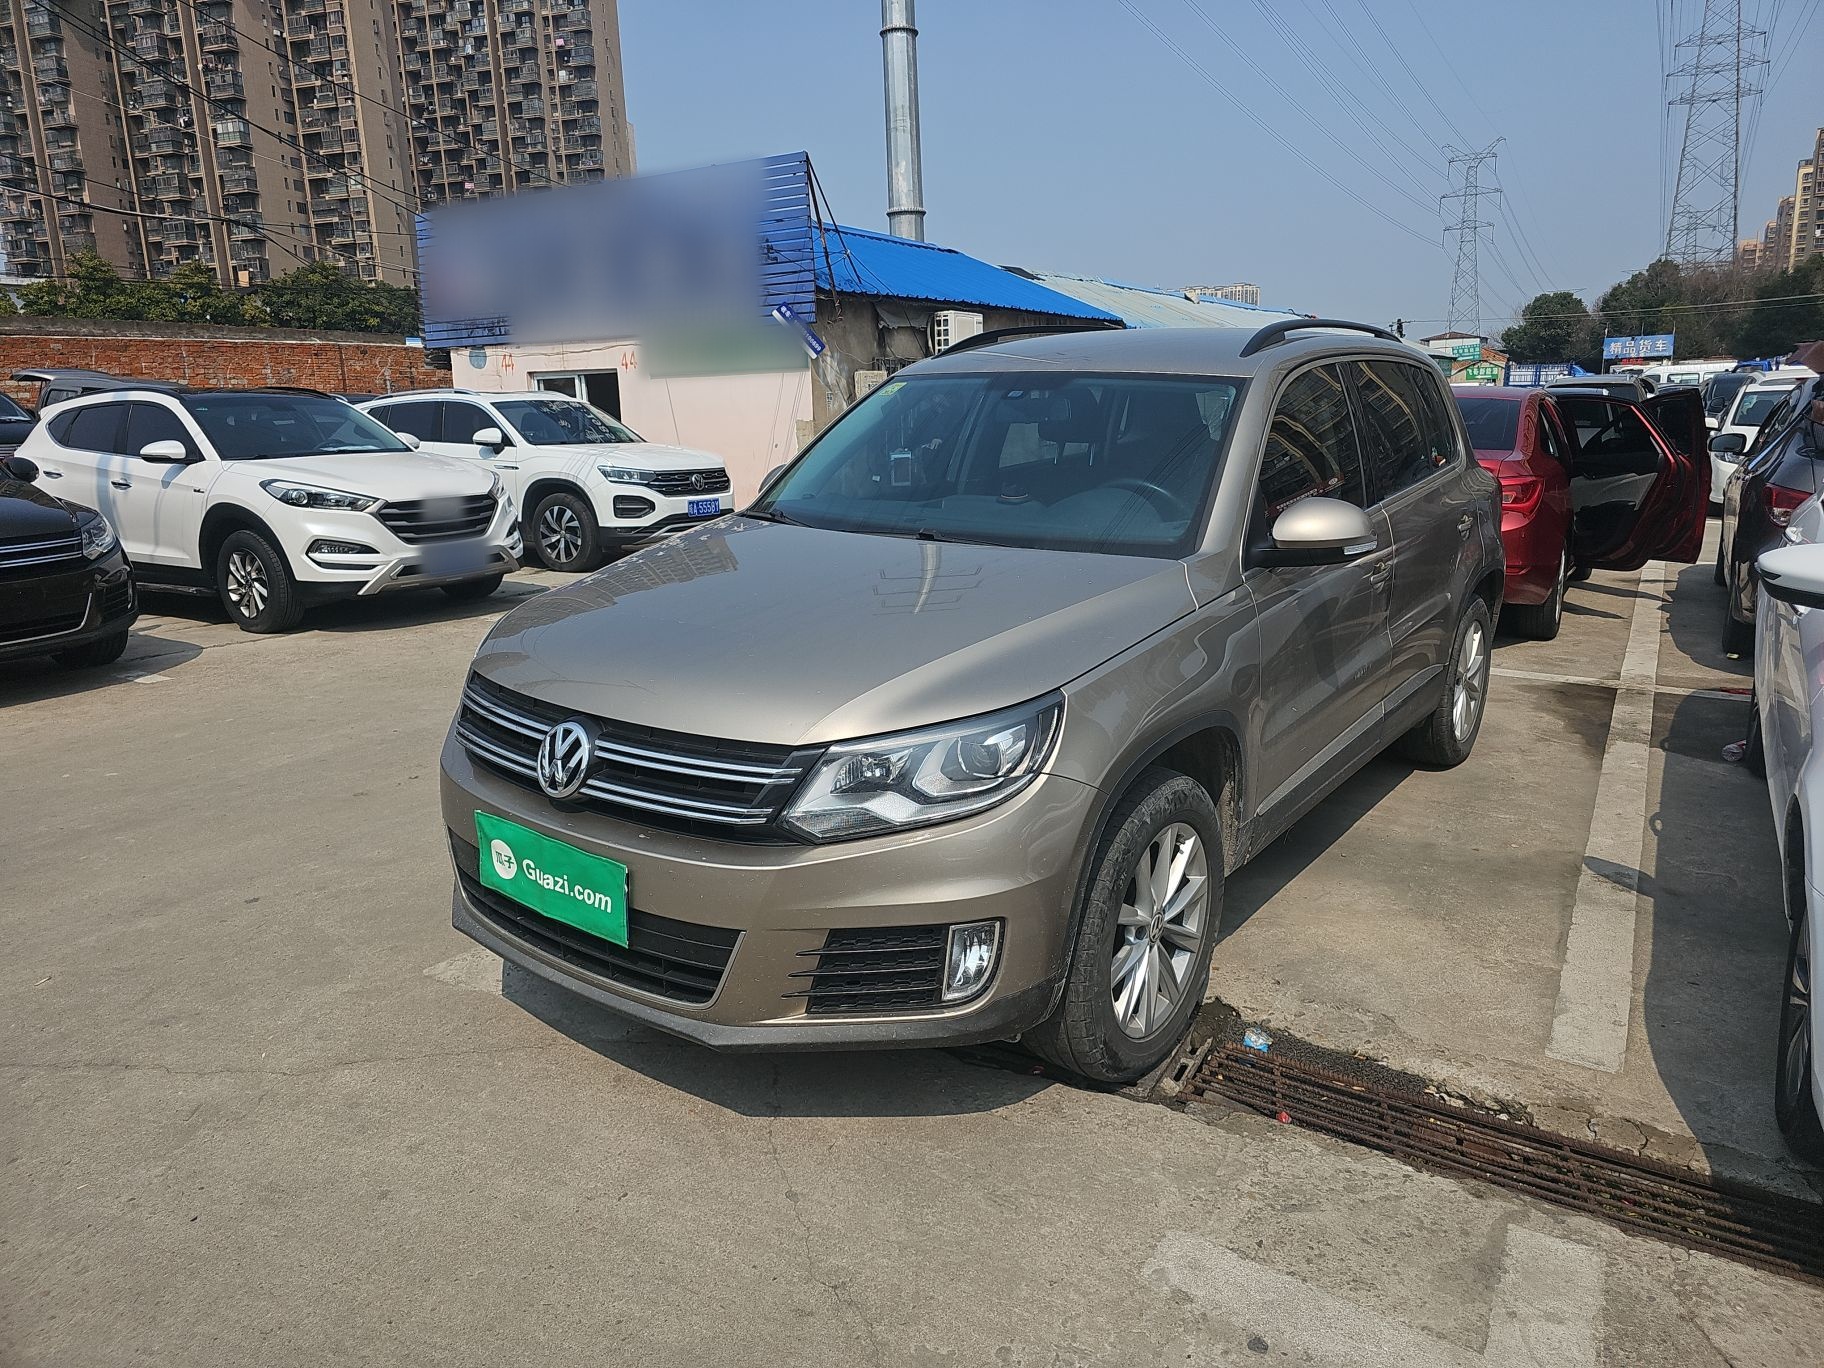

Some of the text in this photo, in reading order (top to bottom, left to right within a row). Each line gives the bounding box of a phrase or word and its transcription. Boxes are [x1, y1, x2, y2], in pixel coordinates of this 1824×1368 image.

[1610, 339, 1668, 354] 精品货车
[522, 858, 612, 914] Guazi.com
